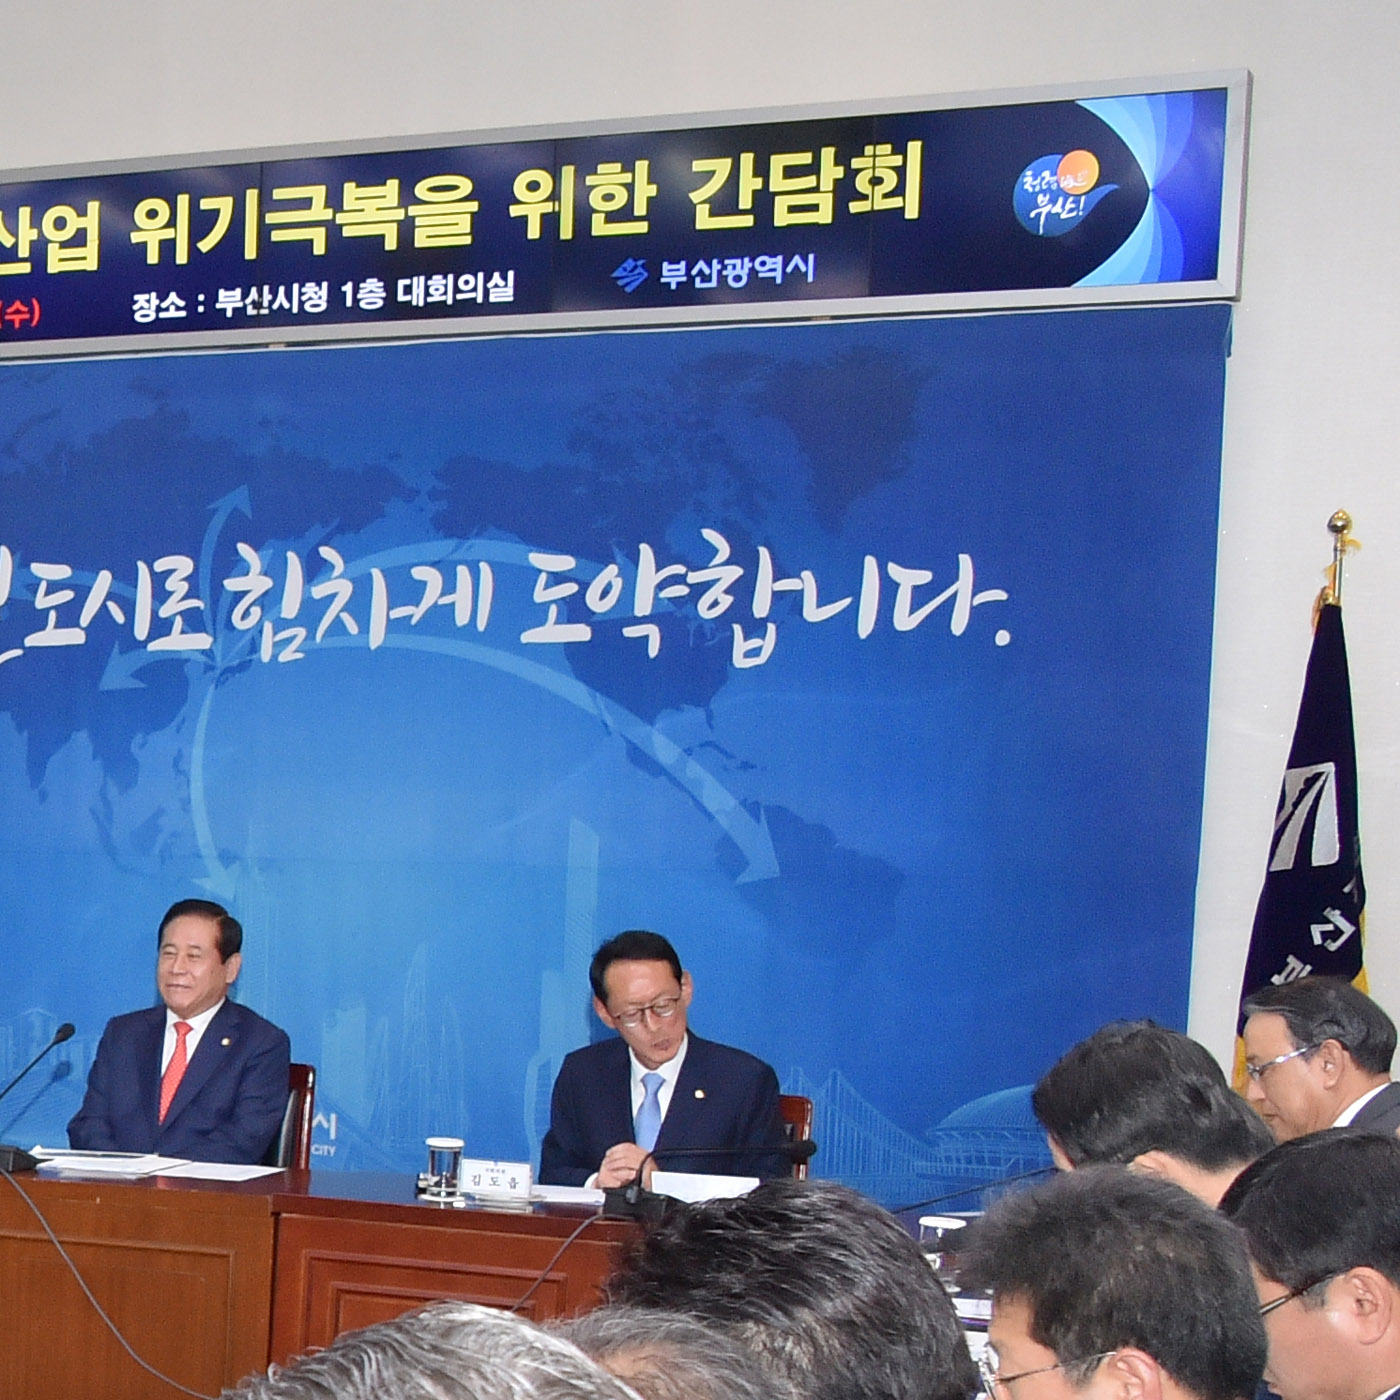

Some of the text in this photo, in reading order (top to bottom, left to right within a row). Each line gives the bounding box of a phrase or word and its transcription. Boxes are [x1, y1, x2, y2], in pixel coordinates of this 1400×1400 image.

[133, 175, 478, 264] 위기극복을
[511, 160, 657, 240] 위한
[690, 140, 923, 230] 간담회
[132, 291, 187, 323] 장소
[215, 281, 328, 318] 부산시청
[341, 278, 387, 310] 1층
[397, 269, 515, 307] 대회의실
[660, 252, 816, 290] 부산광역시
[223, 543, 493, 662] 힘차게
[521, 528, 1010, 668] 도약합니다.
